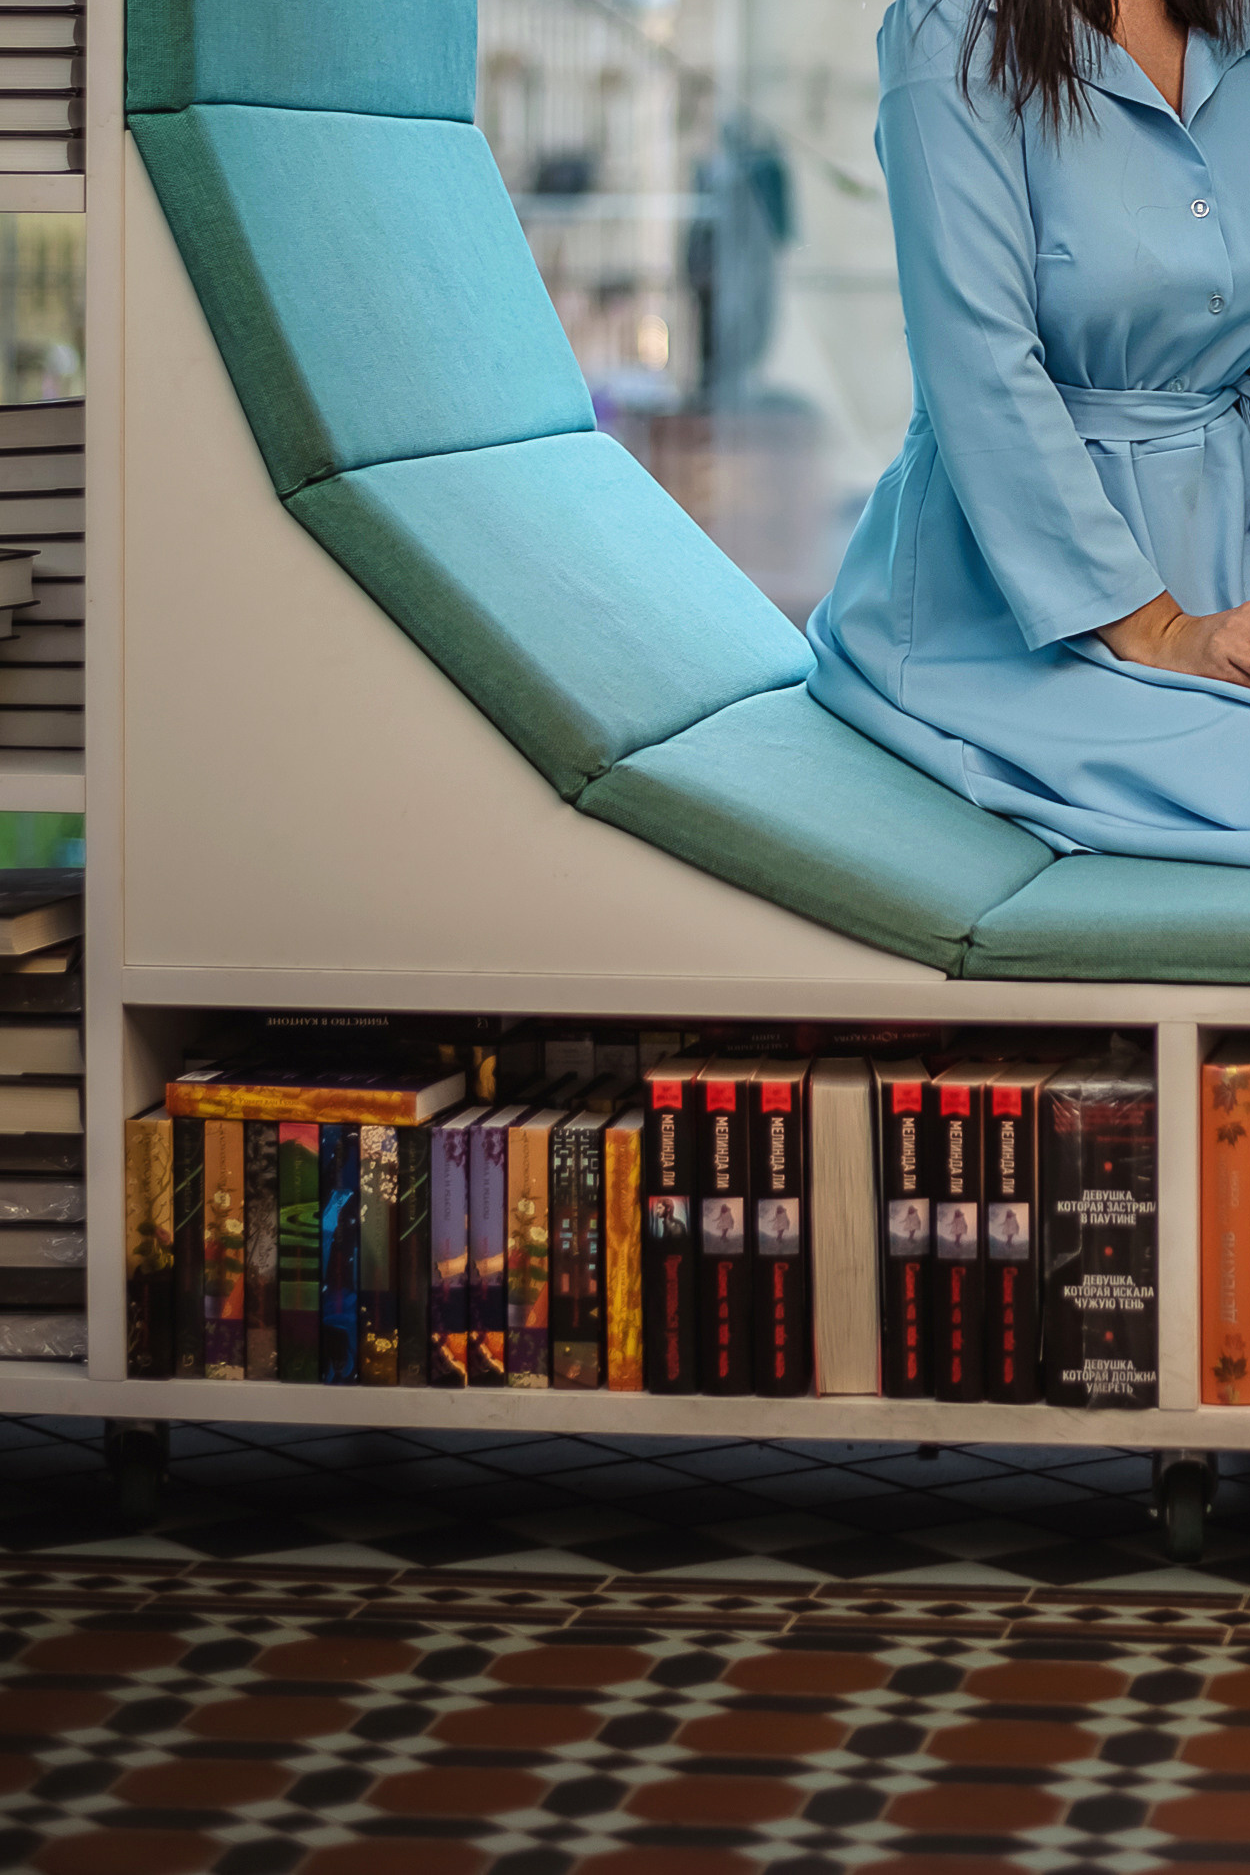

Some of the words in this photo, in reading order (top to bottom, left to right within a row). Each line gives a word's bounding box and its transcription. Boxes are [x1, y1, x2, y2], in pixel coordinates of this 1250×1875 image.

[661, 1114, 676, 1168] МЕЛИНДА
[715, 1116, 730, 1170] МЕЛИНДА
[771, 1117, 785, 1170] МЕЛИНДА
[902, 1117, 916, 1171] МЕЛИНДА
[949, 1120, 963, 1174] МЕЛИНДА
[1001, 1121, 1015, 1174] МЕЛИНДА
[662, 1170, 676, 1186] ЛИ
[717, 1173, 730, 1189] ЛИ
[772, 1173, 786, 1190] ЛИ
[902, 1173, 916, 1190] ЛИ
[949, 1177, 963, 1193] ЛИ
[1001, 1177, 1015, 1194] ЛИ
[1083, 1190, 1135, 1201] ДЕВУШКА,
[1057, 1201, 1103, 1212] КОТОРАЯ
[1081, 1213, 1087, 1224] В
[1090, 1213, 1136, 1225] ПАУТИНЕ
[1083, 1275, 1136, 1286] ДЕВУШКА,
[1064, 1286, 1110, 1297] КОТОРАЯ
[1113, 1287, 1154, 1297] ИСКАЛА
[1075, 1298, 1115, 1309] ЧУЖУЮ
[1119, 1299, 1144, 1309] ТЕНЬ
[1084, 1359, 1136, 1370] ДЕВУШКА,
[1063, 1370, 1108, 1382] КОТОРАЯ
[1112, 1370, 1157, 1382] ДОЛЖНА
[1086, 1382, 1133, 1394] УМЕРЕТЬ
